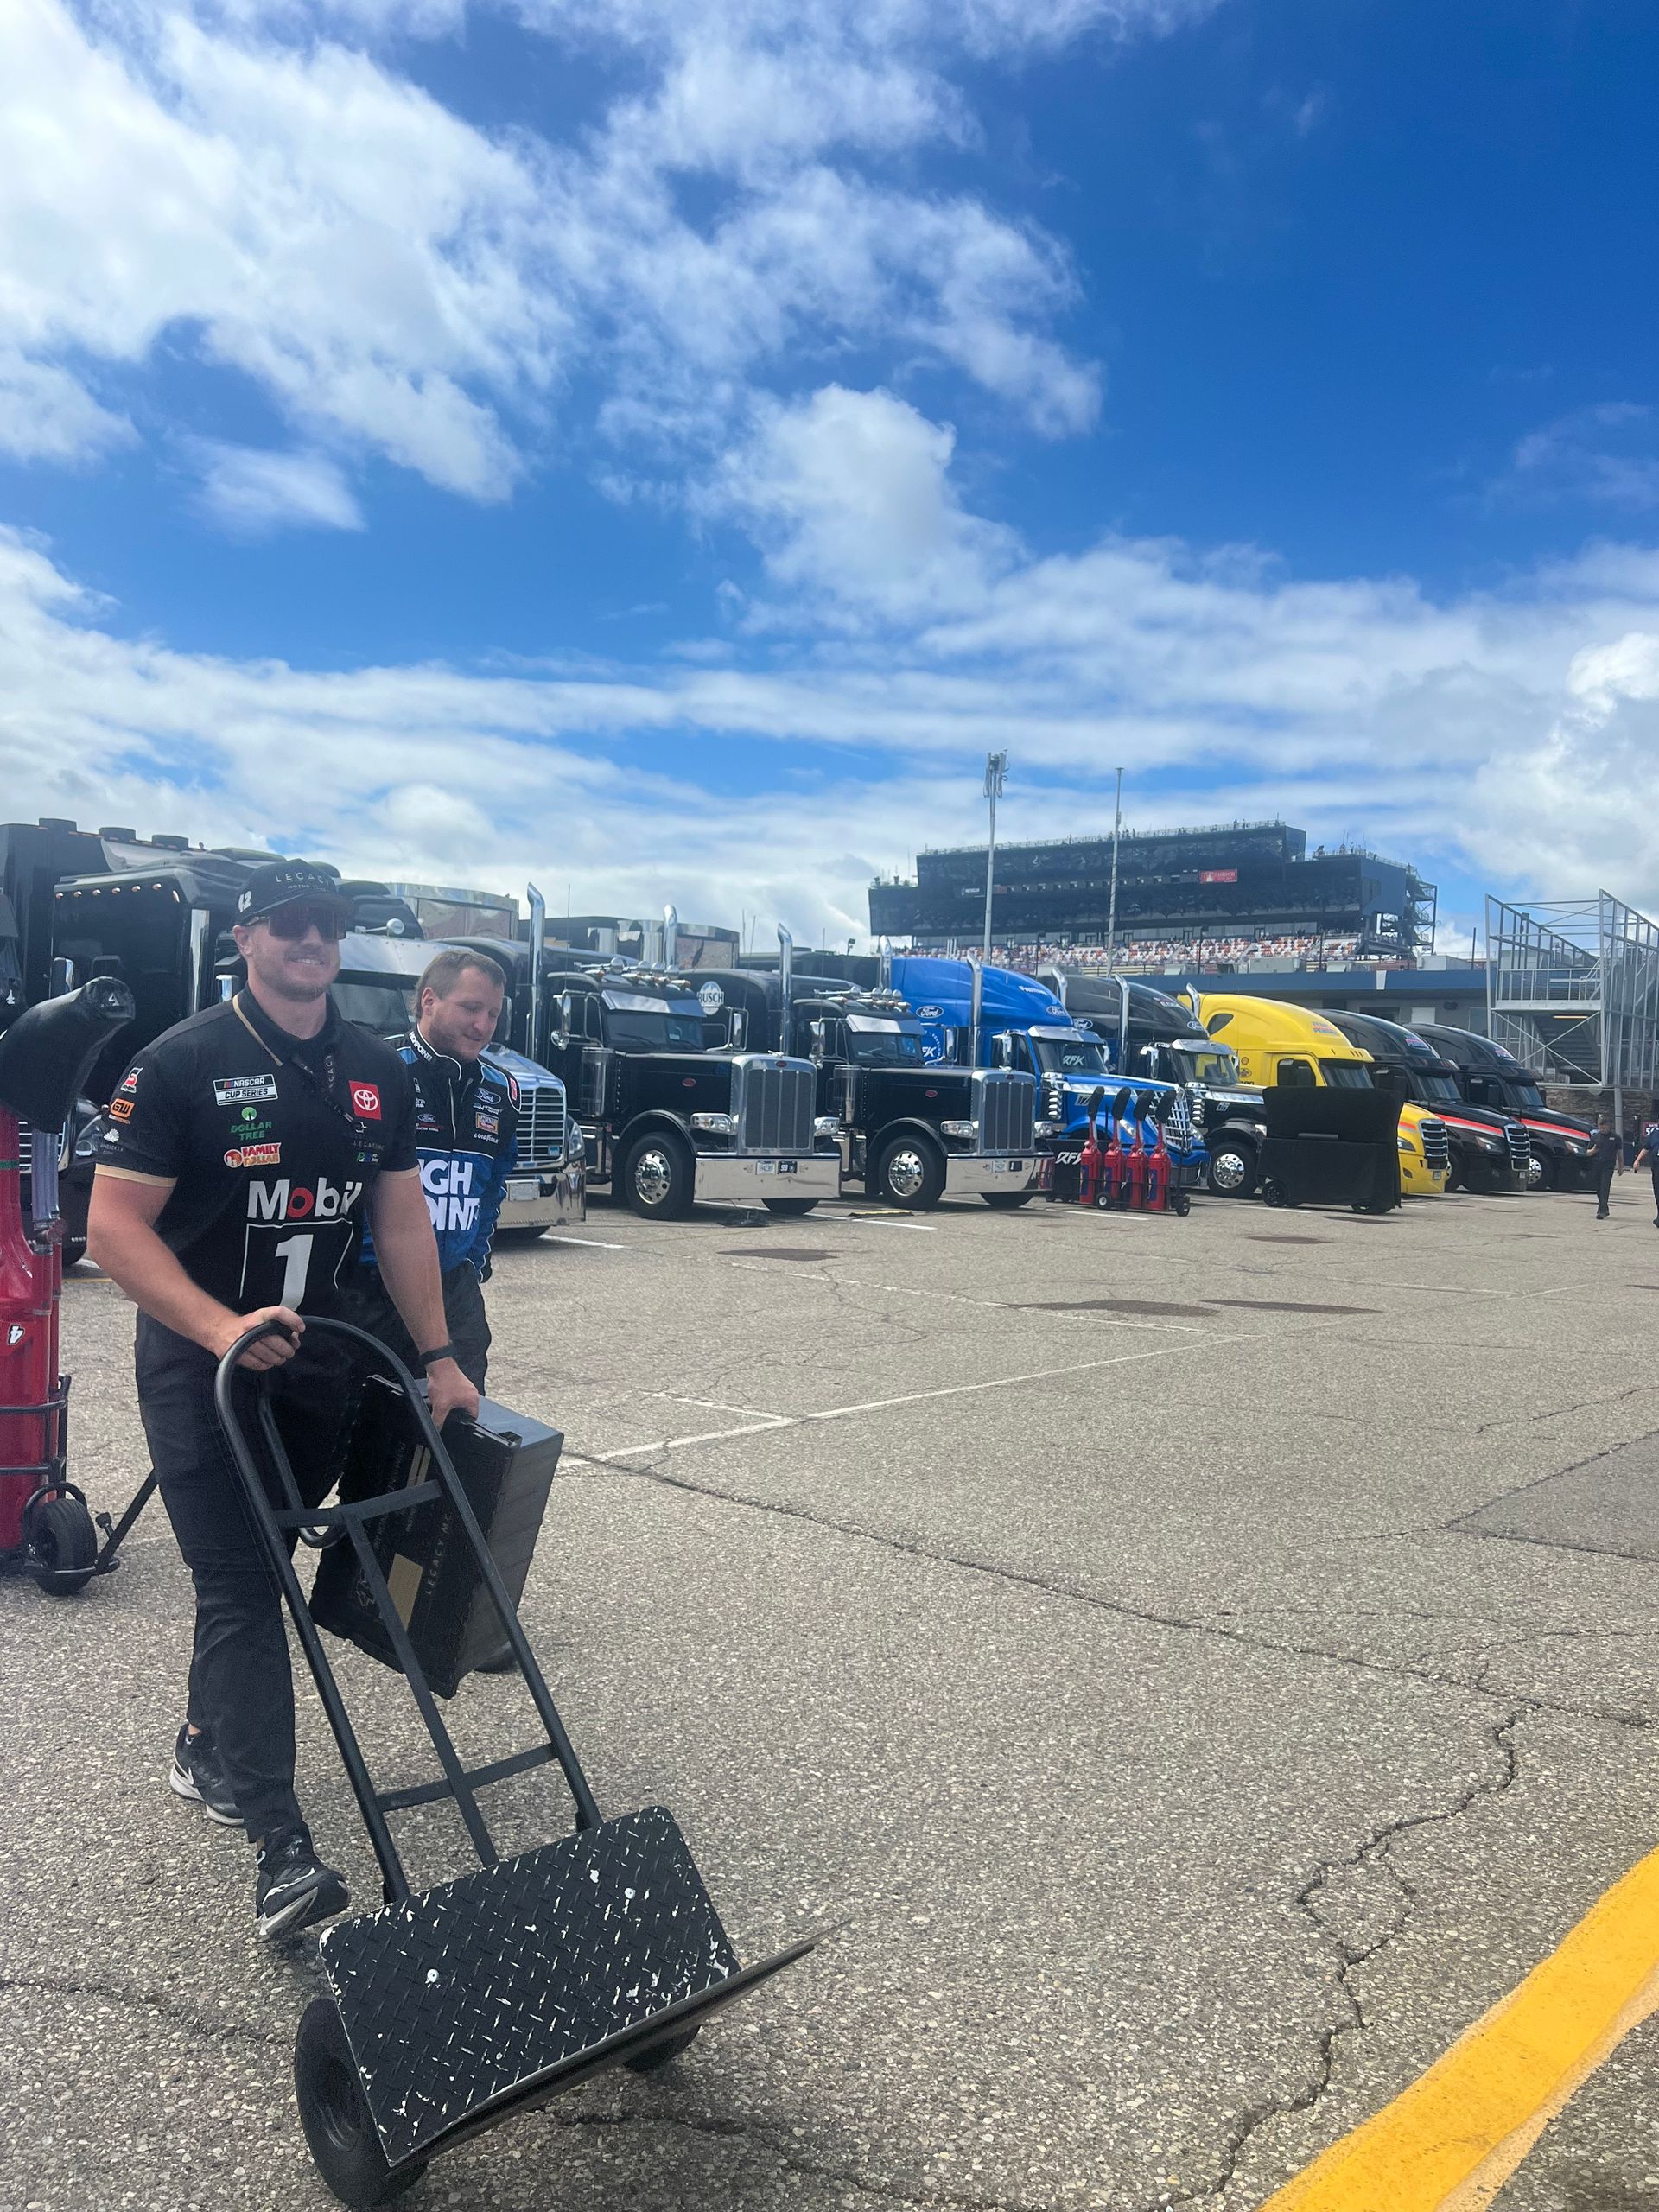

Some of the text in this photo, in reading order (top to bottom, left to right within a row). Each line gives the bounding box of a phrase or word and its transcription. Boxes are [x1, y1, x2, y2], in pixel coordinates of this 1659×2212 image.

[697, 991, 724, 1003] BUSCH
[920, 1006, 940, 1017] Ford
[1063, 1055, 1085, 1065] RFK
[233, 1077, 265, 1088] NASCAR
[225, 1087, 269, 1100] CUP SERIES
[478, 1090, 494, 1103] Ford
[231, 1121, 272, 1134] DOLLAR
[238, 1130, 265, 1141] TREE
[242, 1143, 281, 1157] FAMILY
[244, 1154, 279, 1166] DOLLAR
[275, 1234, 314, 1311] 1
